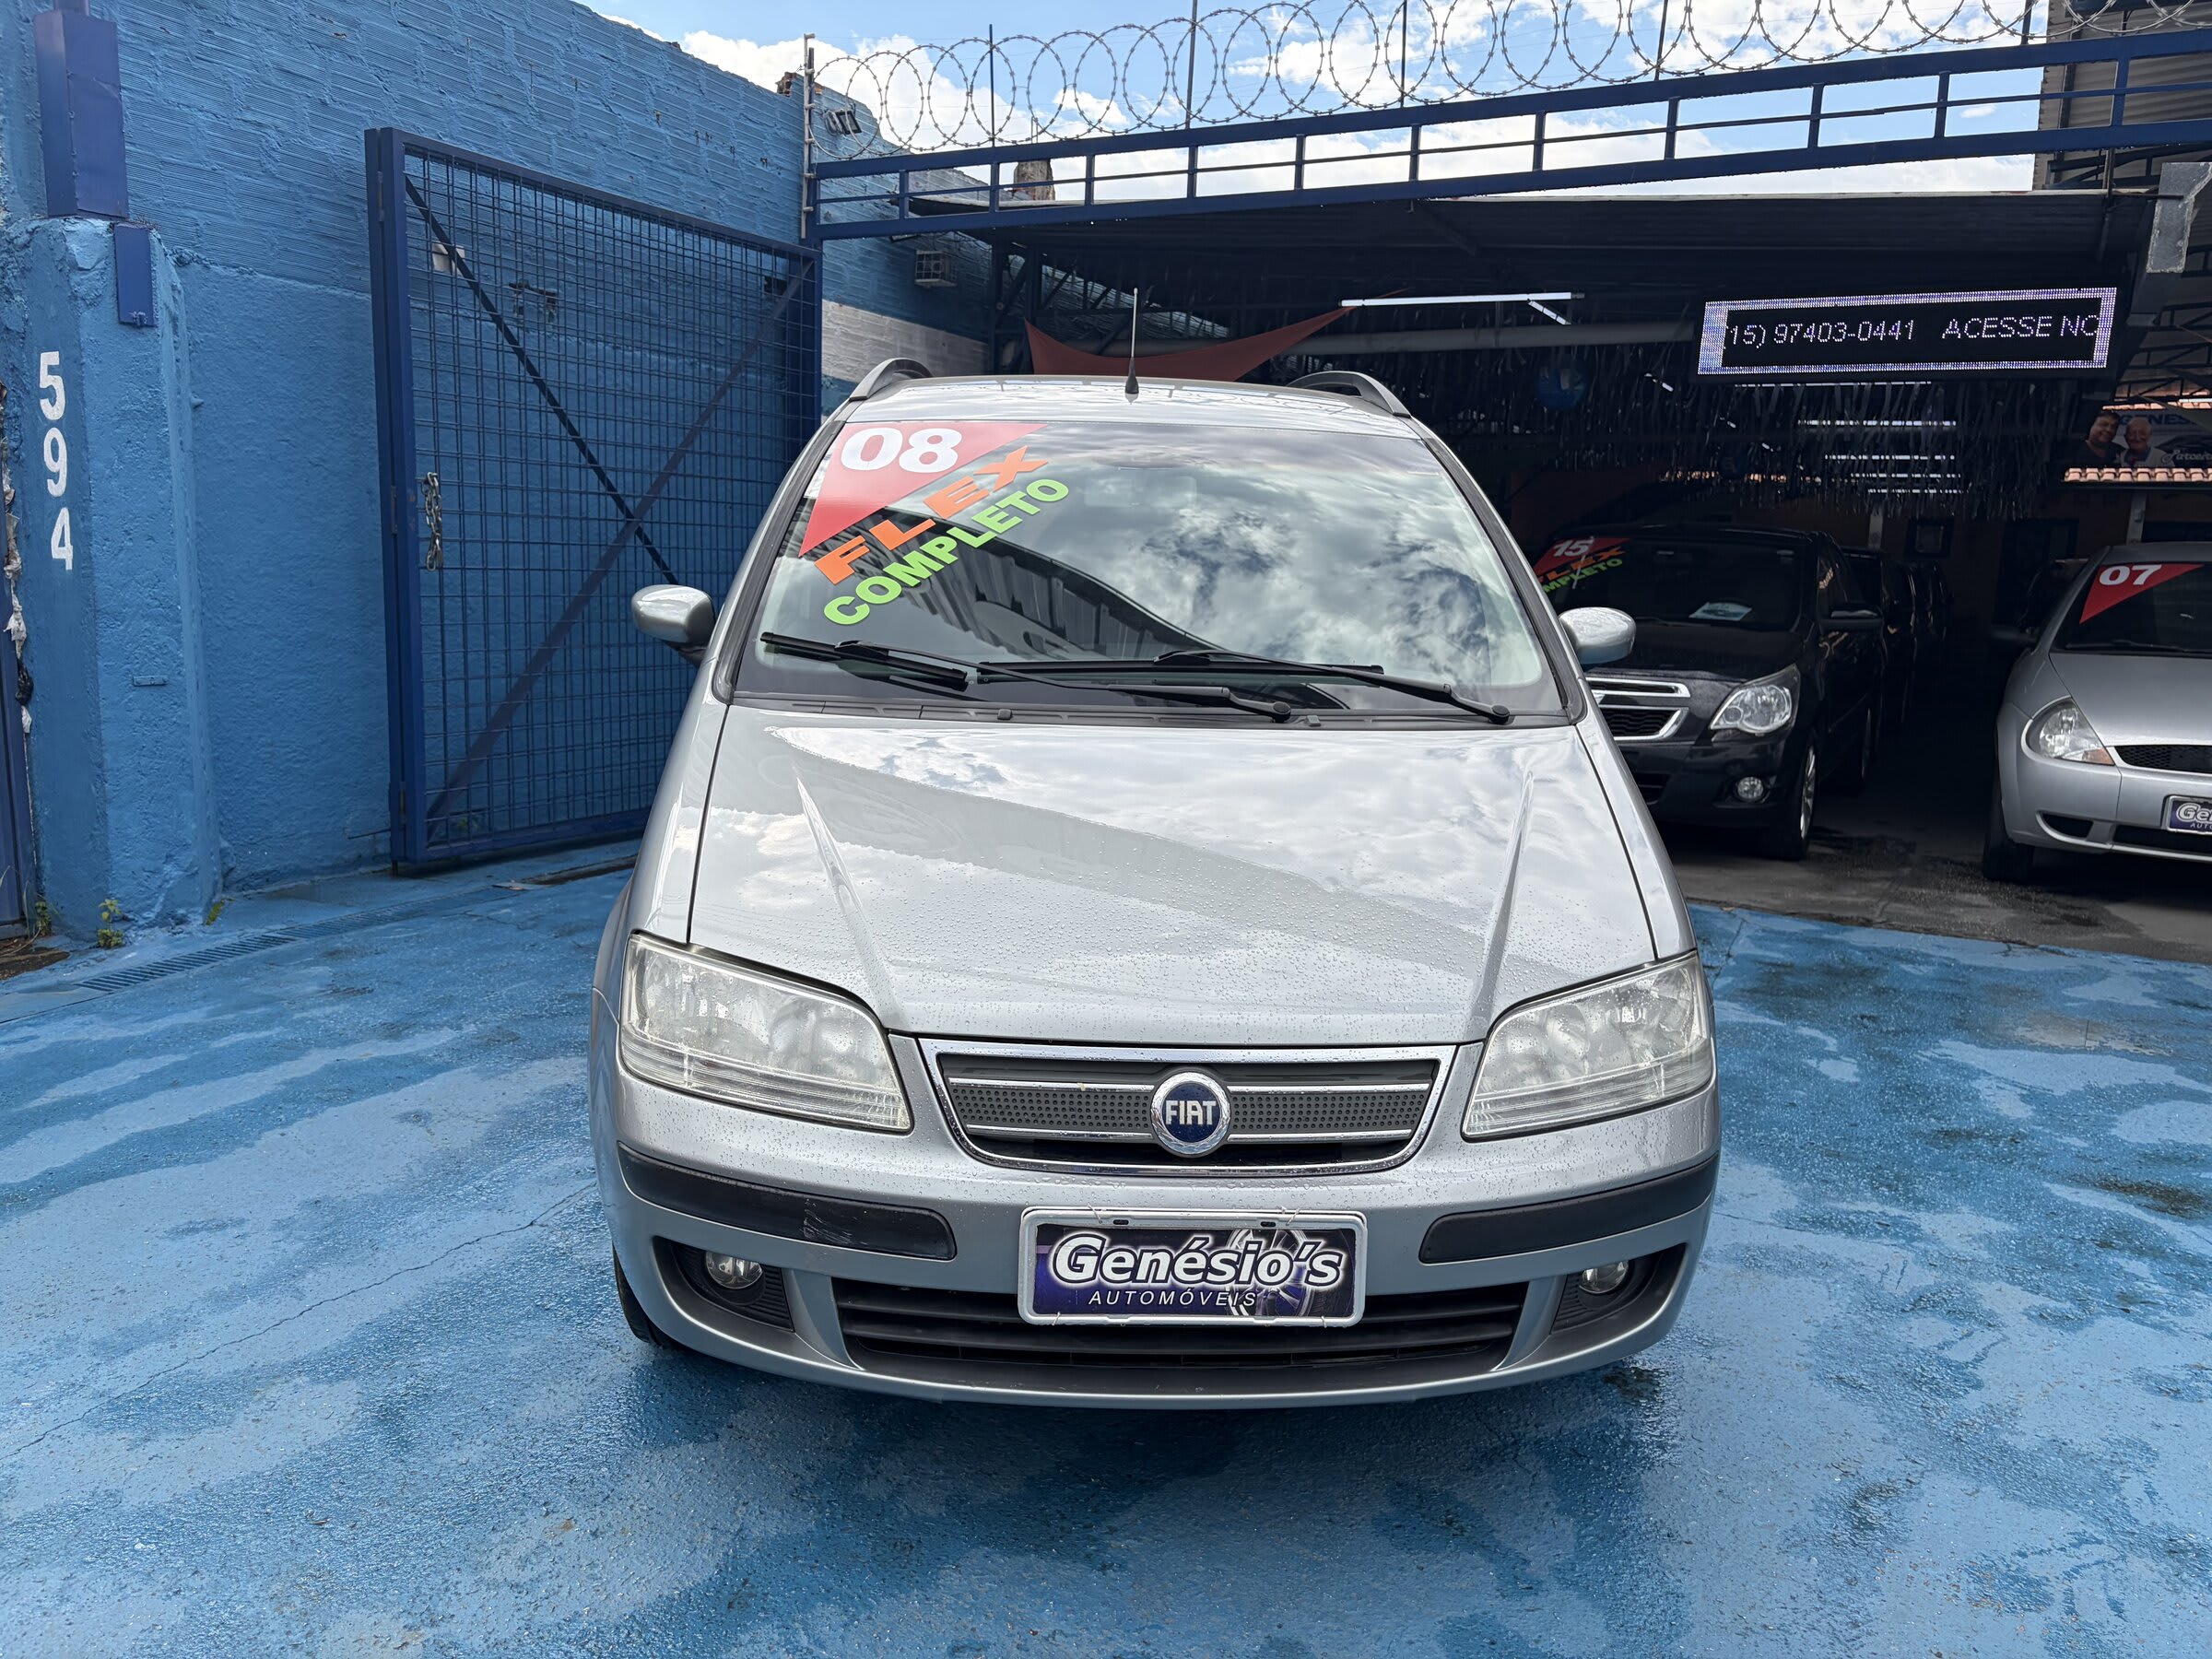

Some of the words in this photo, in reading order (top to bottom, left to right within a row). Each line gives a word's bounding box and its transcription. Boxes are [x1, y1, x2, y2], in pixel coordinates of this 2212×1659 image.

[1772, 319, 1914, 345] 97403-0441
[1941, 315, 2053, 339] ACESSE
[39, 350, 74, 571] 594
[840, 427, 962, 474] 08
[814, 445, 1049, 584] FLEX
[823, 478, 1069, 625] COMPLETO
[1552, 537, 1594, 558] 15
[1541, 559, 1623, 594] MPLETO
[2099, 564, 2162, 585] 07
[2176, 803, 2212, 823] Ge
[1165, 1100, 1217, 1126] FIAT
[1052, 1233, 1344, 1288] Genésio's
[1088, 1287, 1257, 1306] AUTOMÓVEIS
